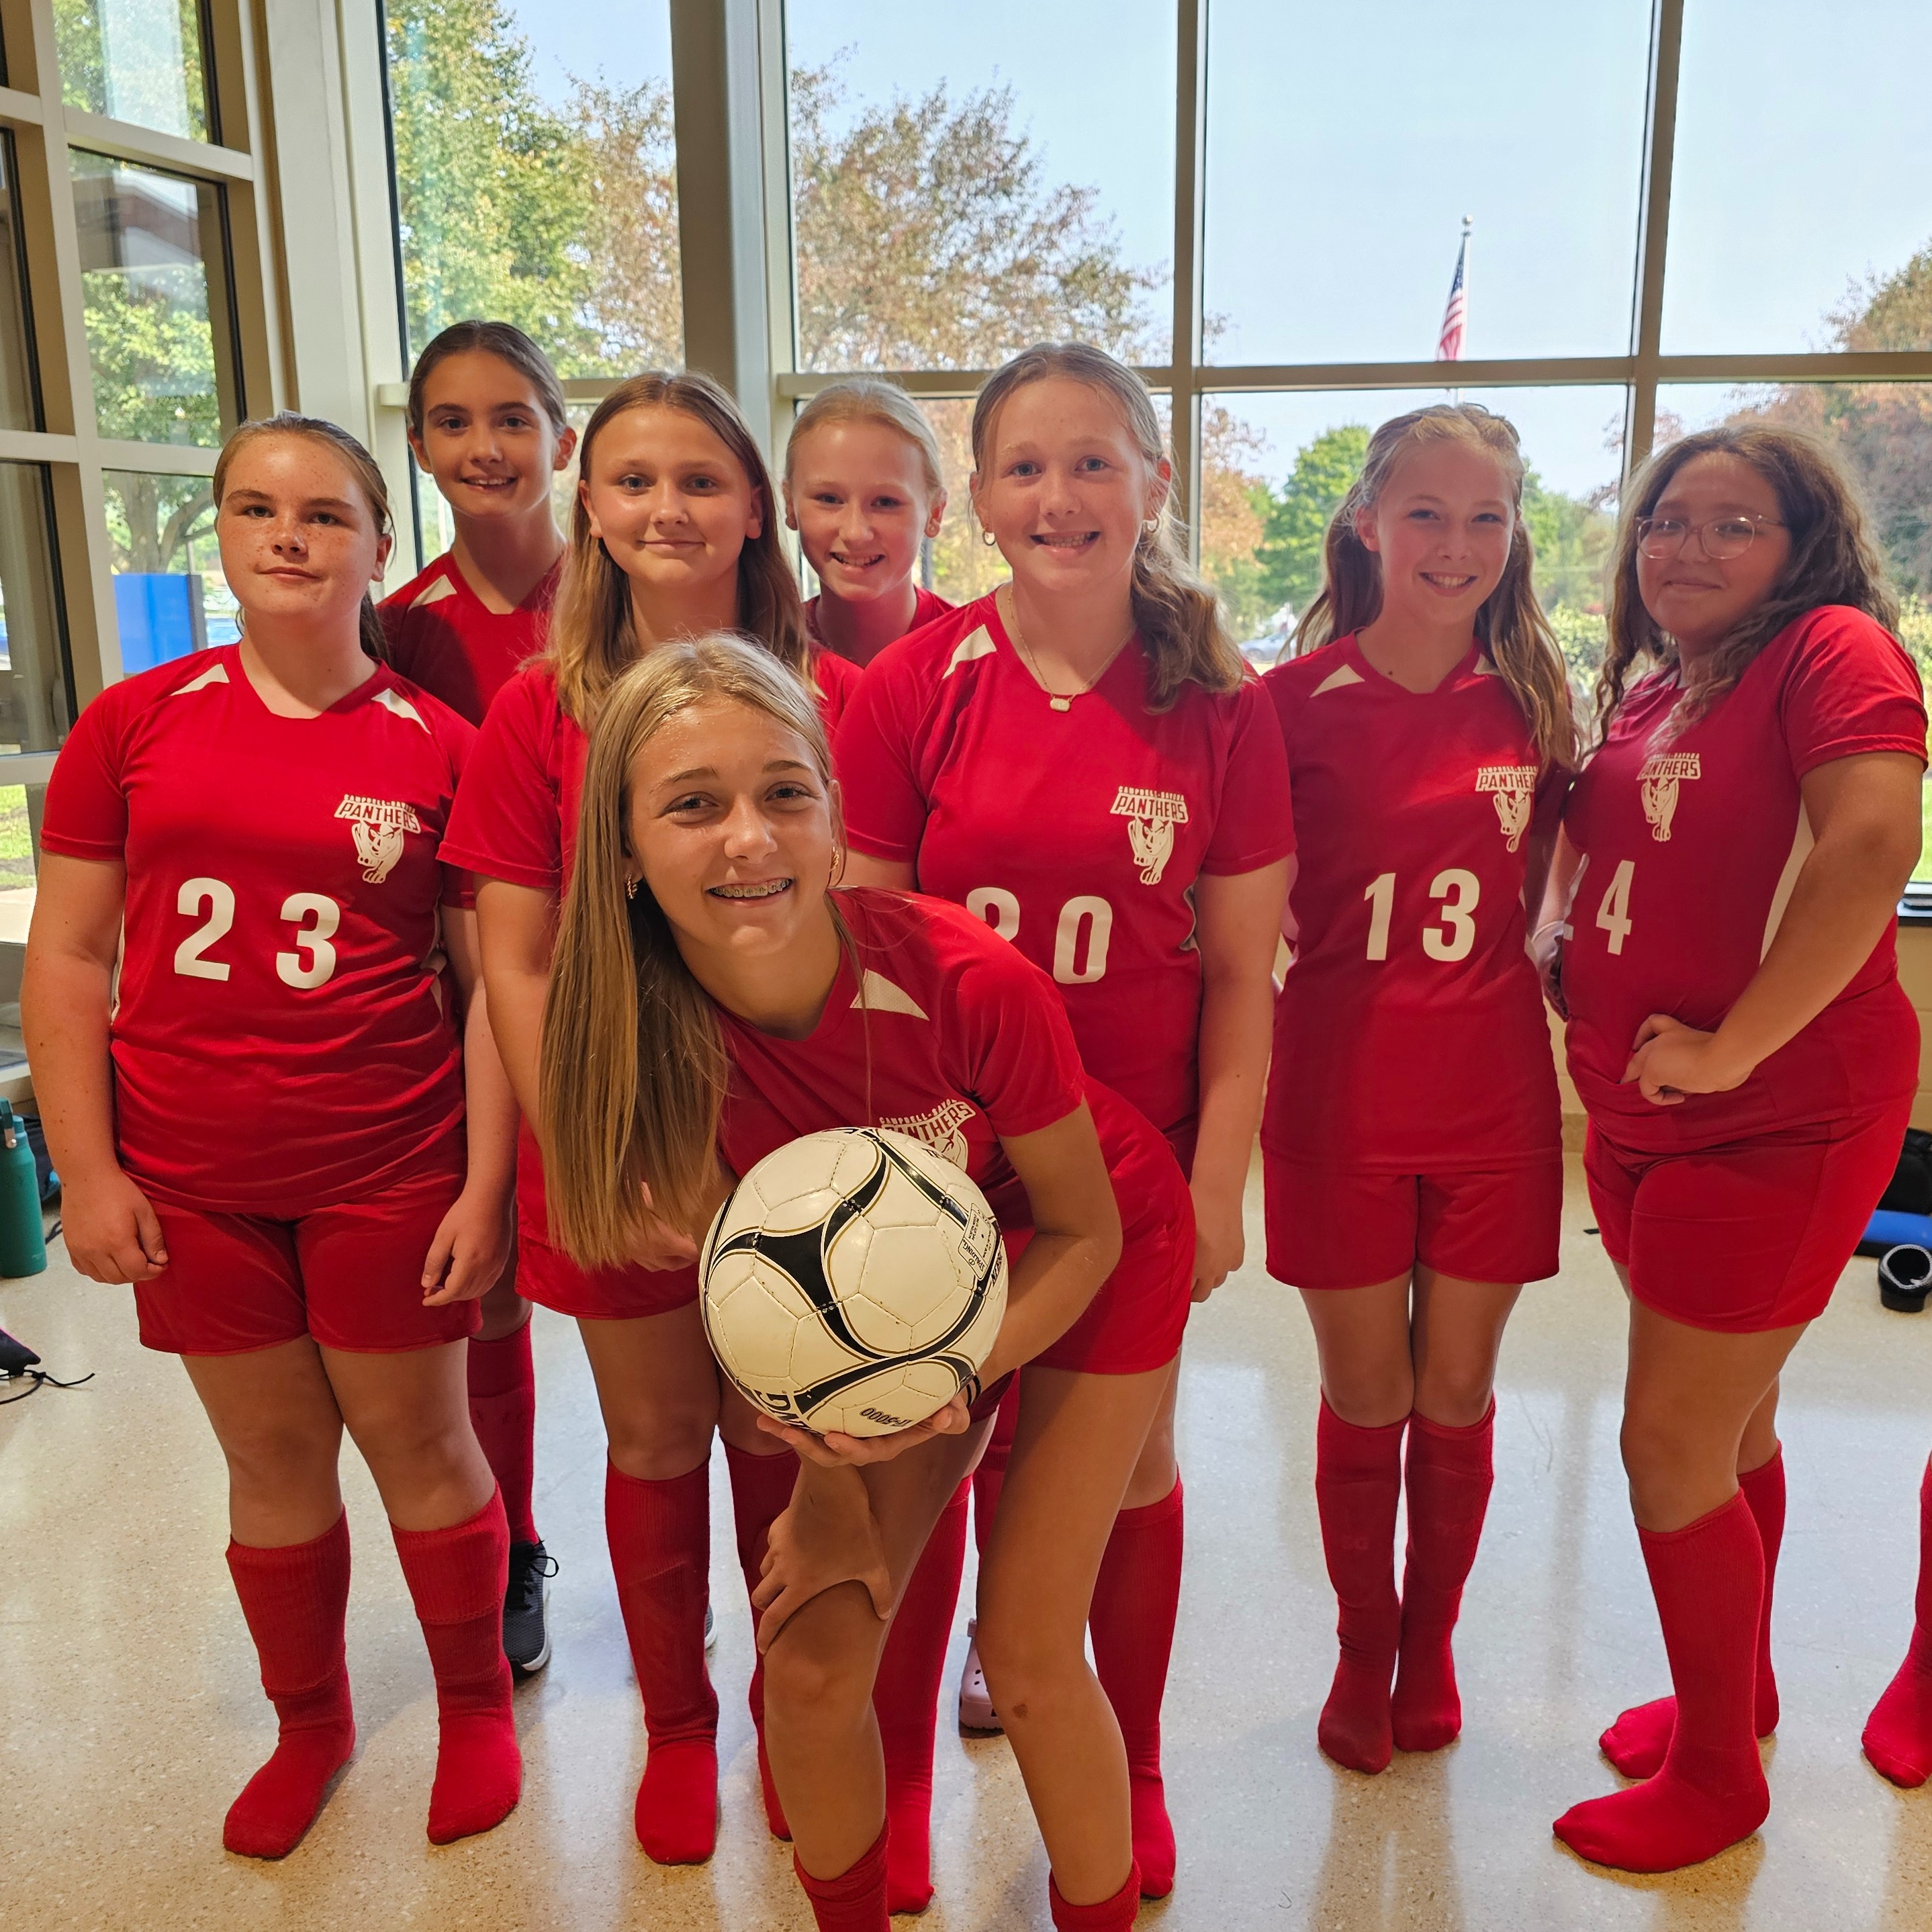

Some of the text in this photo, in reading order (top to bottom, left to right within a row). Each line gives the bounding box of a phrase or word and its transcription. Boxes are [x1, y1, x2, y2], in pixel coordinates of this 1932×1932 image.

[1478, 774, 1536, 790] PANTHER
[338, 802, 419, 831] PANTHERS
[1114, 795, 1186, 820] PANTHERS
[962, 1240, 986, 1273] SPALDING
